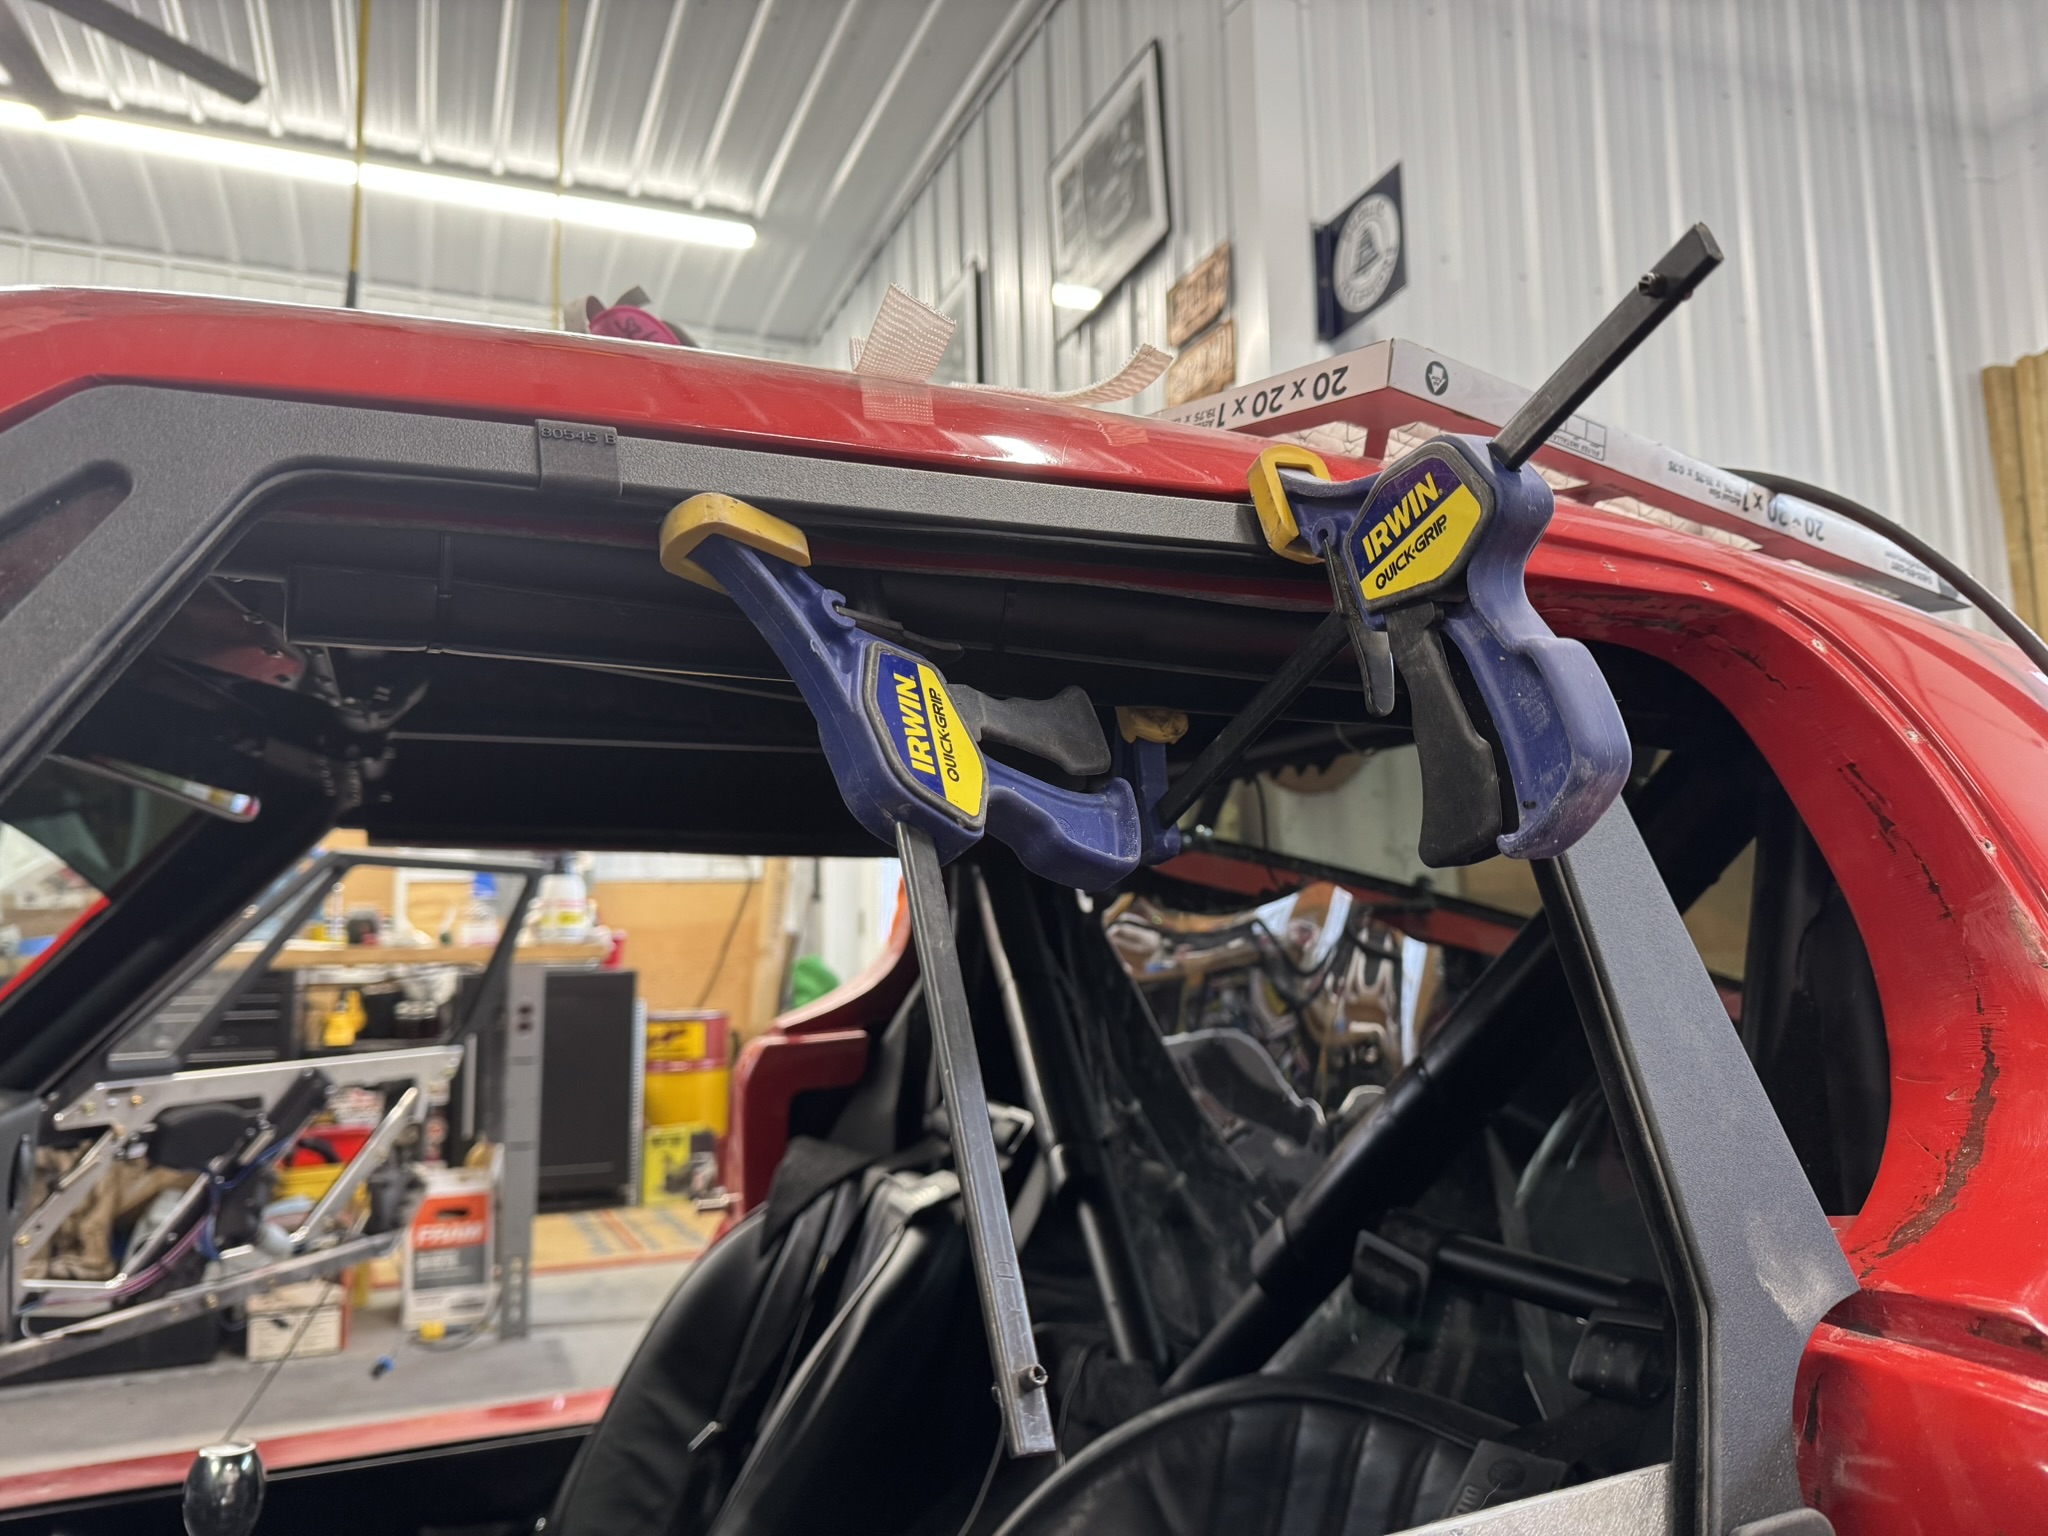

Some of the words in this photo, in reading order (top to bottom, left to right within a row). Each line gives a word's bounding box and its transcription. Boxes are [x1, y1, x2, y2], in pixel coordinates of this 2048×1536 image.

[1290, 377, 1307, 400] x
[1312, 365, 1349, 401] 20
[1231, 395, 1248, 418] x
[1252, 384, 1286, 418] 20
[1217, 402, 1226, 428] 1
[541, 427, 599, 444] 80545
[605, 433, 617, 446] B
[1753, 492, 1763, 511] x
[1361, 471, 1439, 565] IRWIN
[1804, 516, 1825, 542] 20
[893, 672, 937, 776] IRWIN
